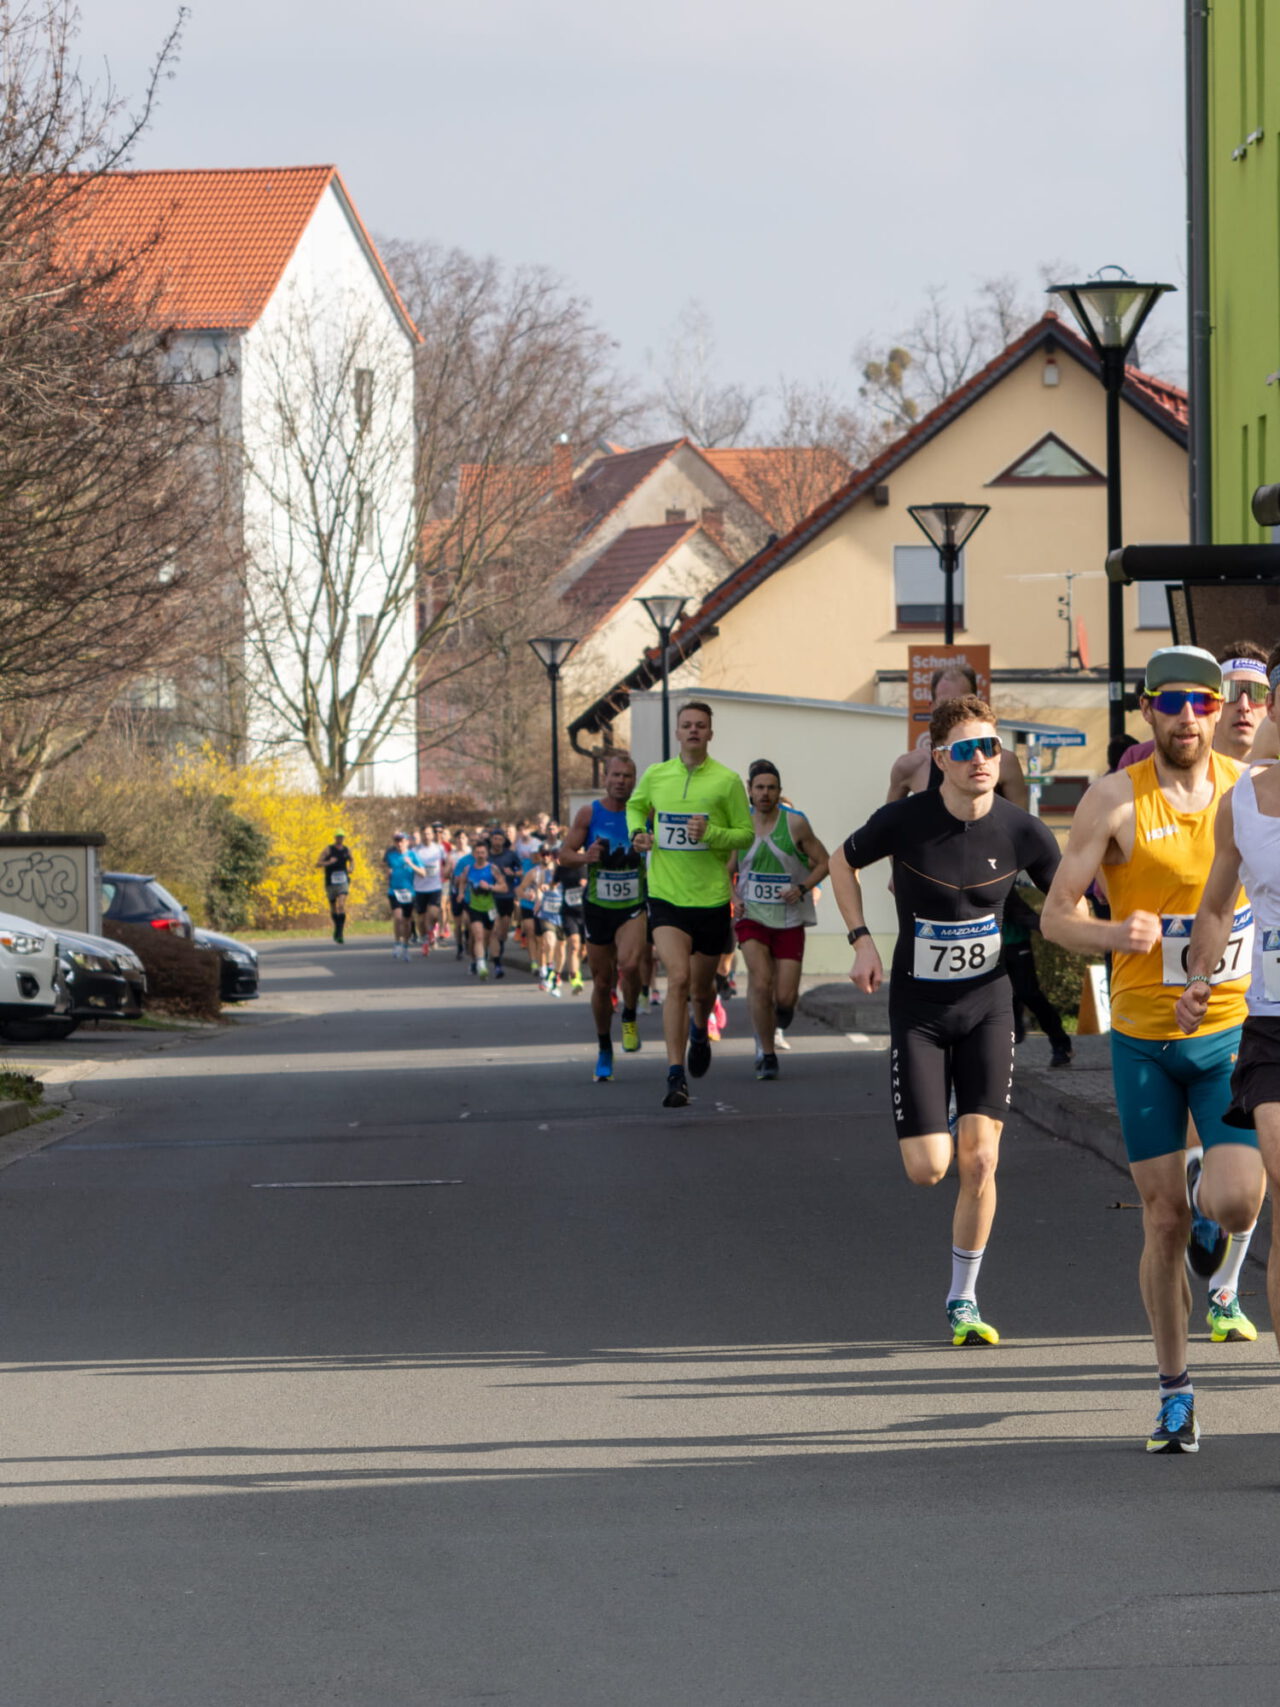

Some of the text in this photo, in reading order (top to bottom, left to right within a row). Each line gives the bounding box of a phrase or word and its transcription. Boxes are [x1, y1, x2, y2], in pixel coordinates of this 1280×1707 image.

[605, 881, 631, 897] 195
[754, 884, 783, 900] 035
[929, 943, 986, 973] 738
